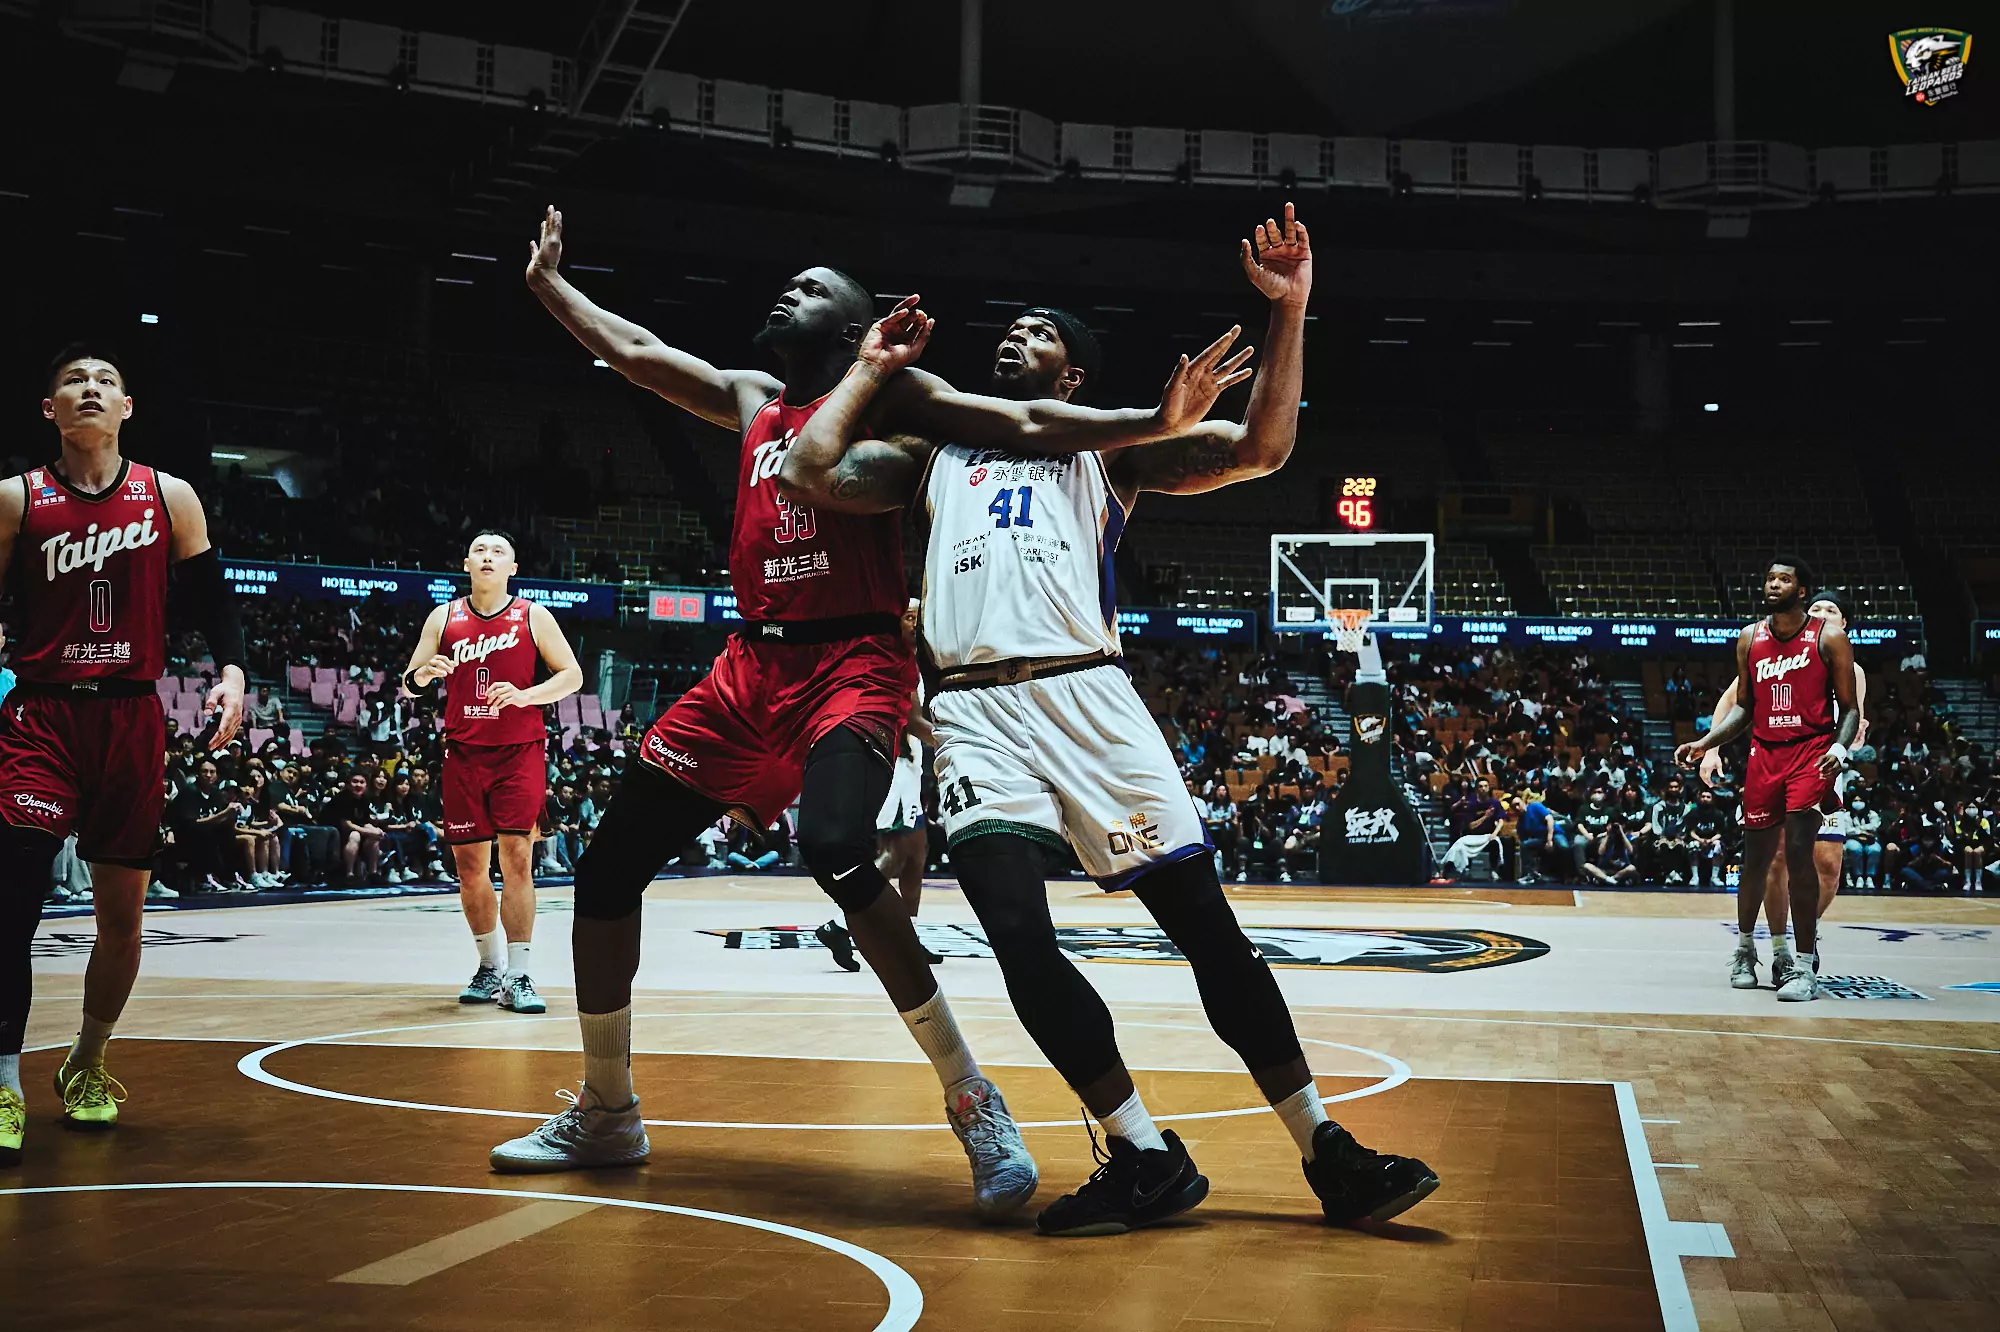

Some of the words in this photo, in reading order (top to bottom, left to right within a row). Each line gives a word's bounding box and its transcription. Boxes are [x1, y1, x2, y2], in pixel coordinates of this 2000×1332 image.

[988, 486, 1034, 528] 41
[41, 508, 159, 581] Taipei
[763, 550, 830, 578] 新光三越
[321, 577, 357, 588] HOTEL
[517, 588, 551, 600] HOTEL
[552, 590, 589, 603] INDIGO
[90, 580, 111, 633] 0
[655, 595, 699, 618] 出口
[1176, 616, 1208, 627] HOTEL
[1525, 625, 1556, 635] HOTEL
[1557, 626, 1593, 636] INDIGO
[1675, 627, 1706, 638] HOTEL
[1707, 628, 1741, 638] INDIGO
[1860, 629, 1897, 639] INDIGO
[62, 641, 131, 659] 新光三越
[452, 625, 520, 668] Taipei
[1756, 646, 1811, 683] Taipei
[476, 666, 490, 700] 8
[1771, 683, 1792, 711] 10
[649, 734, 698, 768] Cherubic
[14, 794, 64, 815] Cherubic
[943, 776, 982, 817] 41
[1107, 823, 1165, 855] ONE
